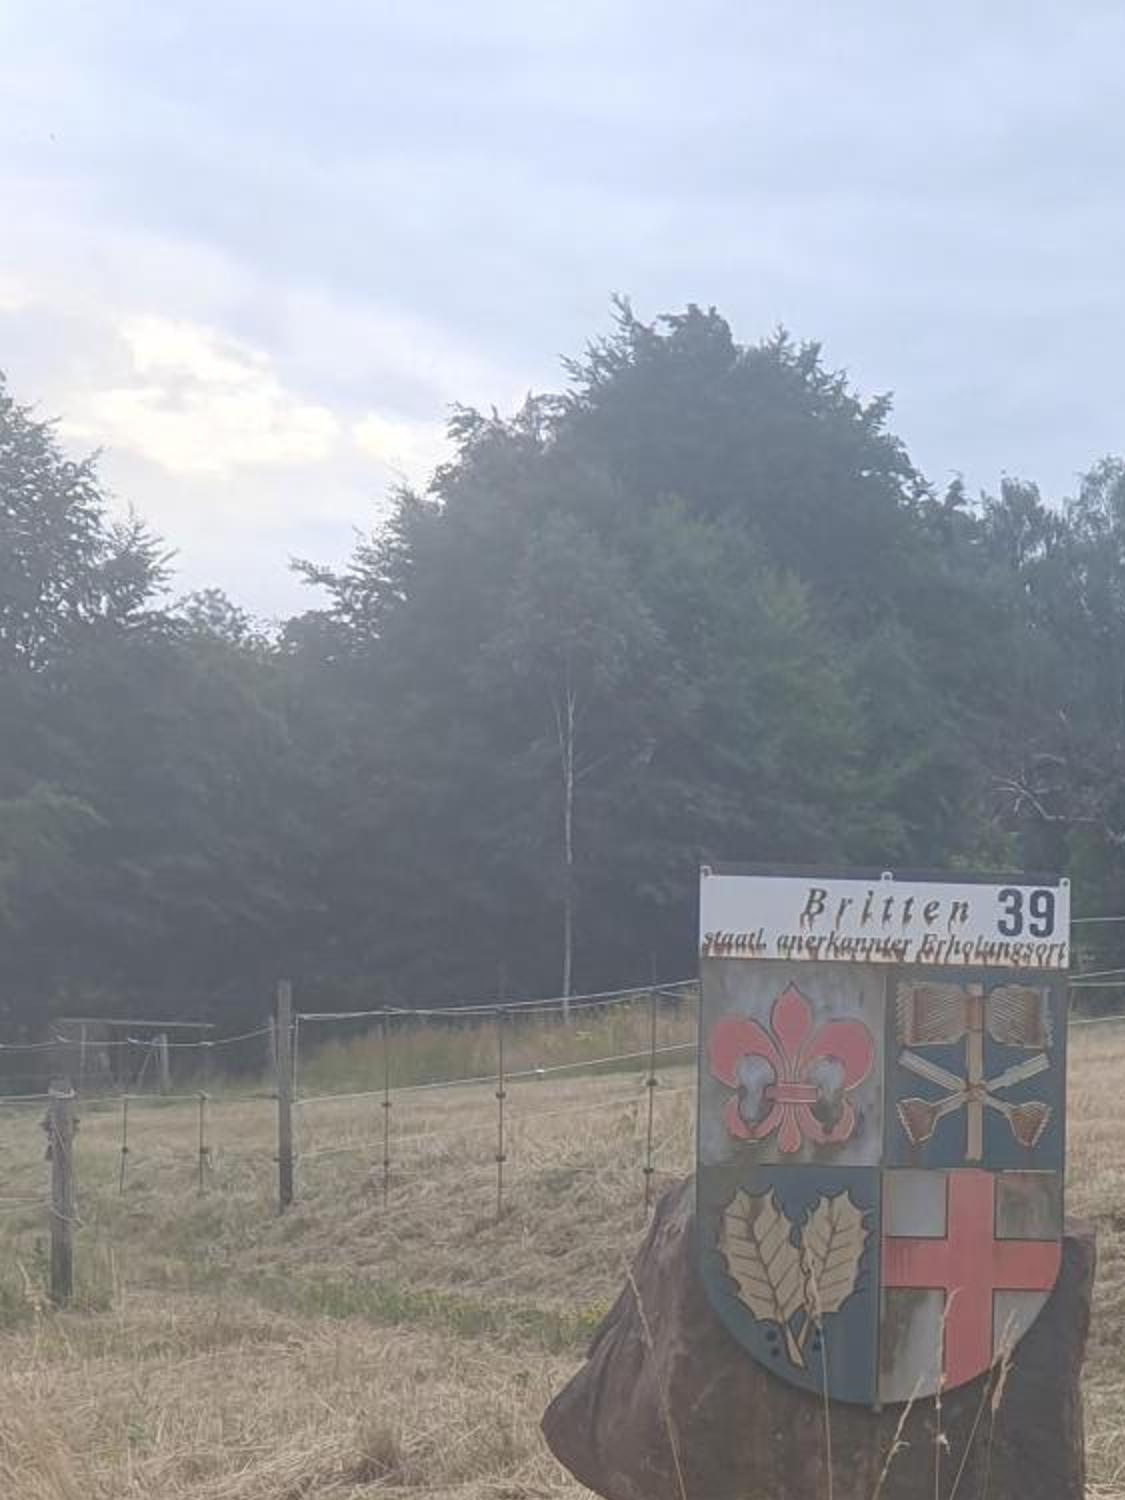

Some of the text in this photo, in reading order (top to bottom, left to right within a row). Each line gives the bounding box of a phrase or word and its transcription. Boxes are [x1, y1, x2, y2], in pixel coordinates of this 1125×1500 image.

[802, 888, 969, 926] Britten
[997, 888, 1055, 938] 39
[703, 928, 1066, 963] staatl. anerkannter Erholungsort
